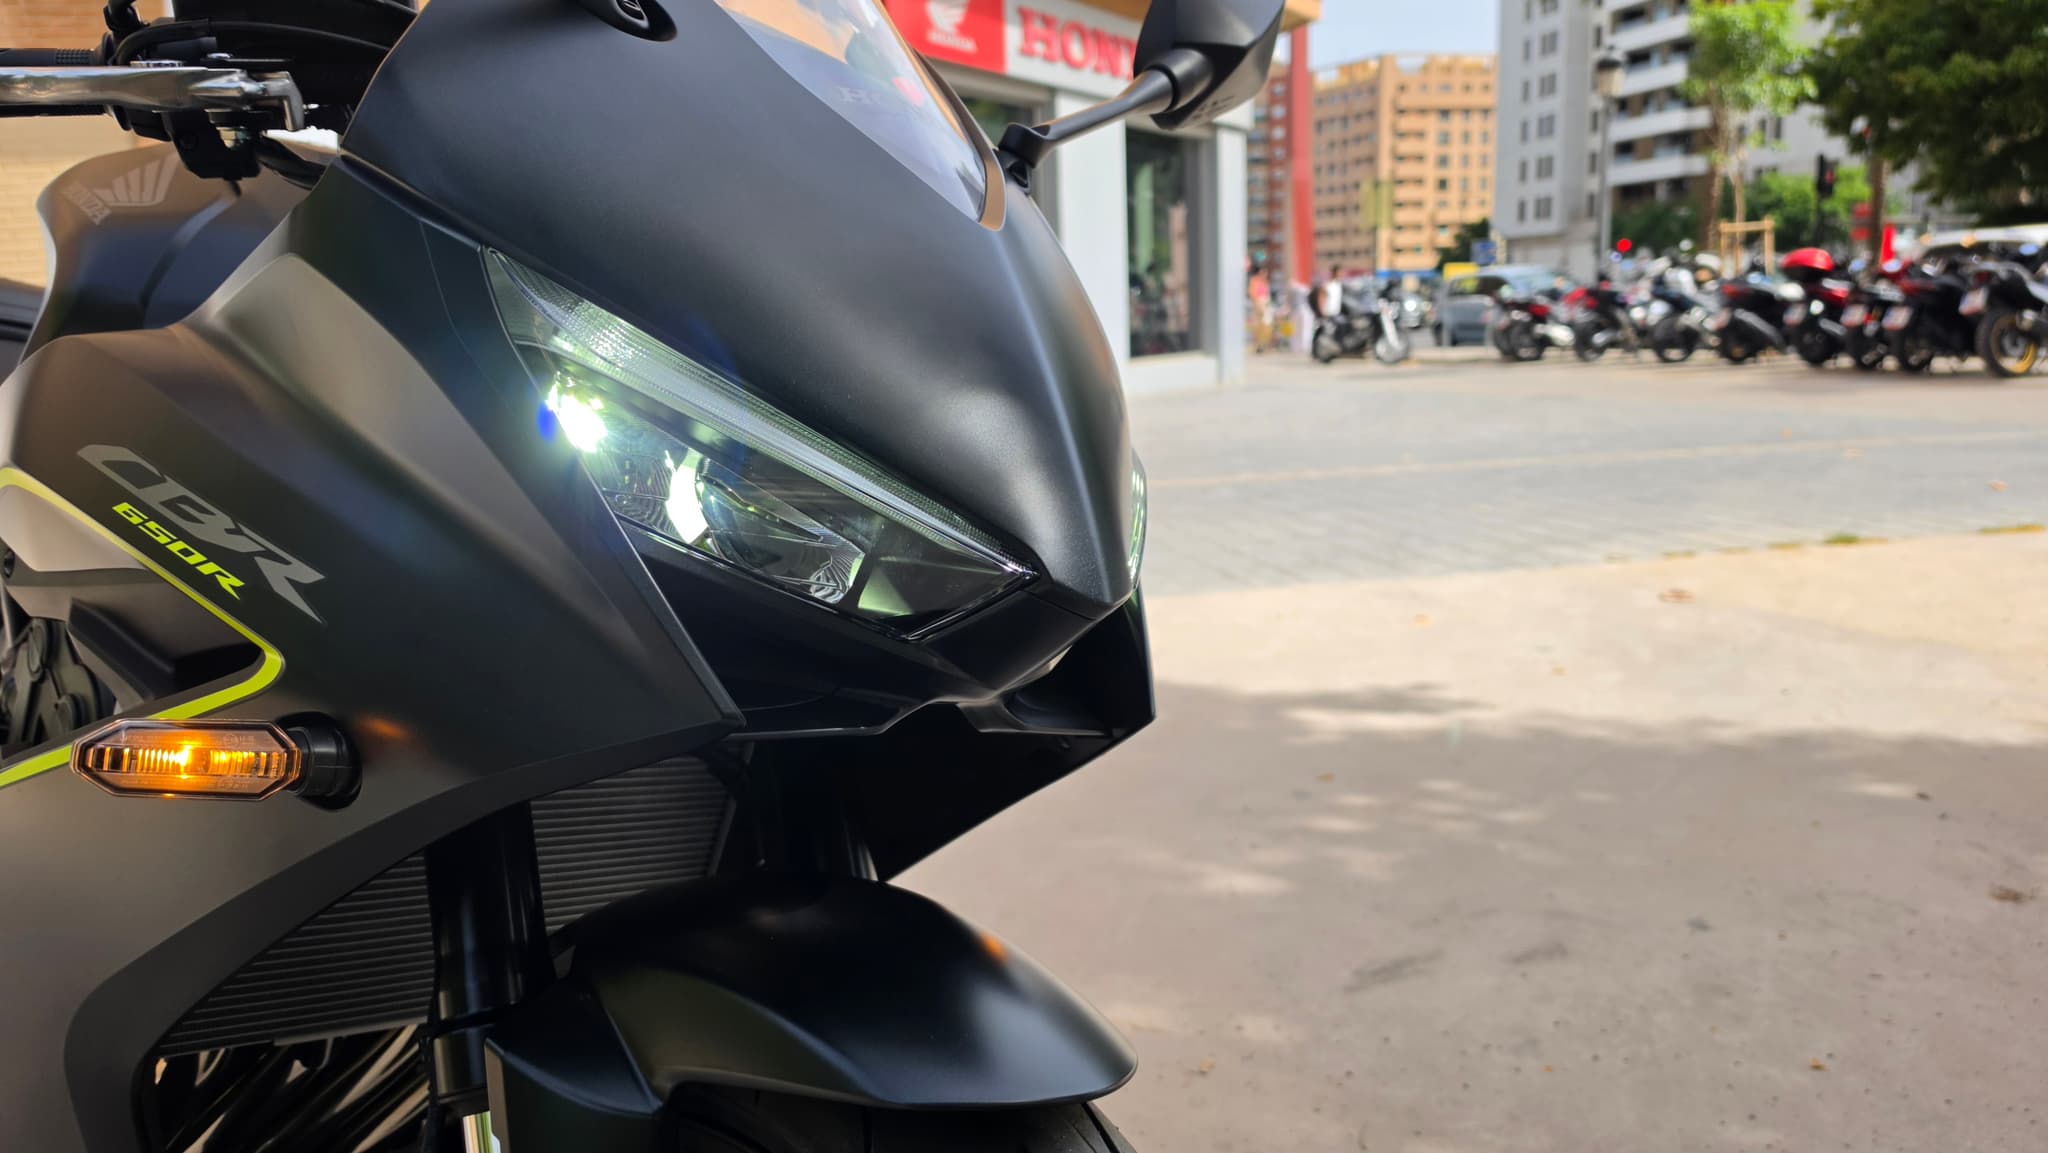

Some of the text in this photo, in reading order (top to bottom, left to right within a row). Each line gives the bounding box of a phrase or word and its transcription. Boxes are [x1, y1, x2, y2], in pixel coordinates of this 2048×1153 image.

[1017, 6, 1136, 82] HON
[77, 444, 326, 624] CBR
[112, 502, 245, 600] 650R
